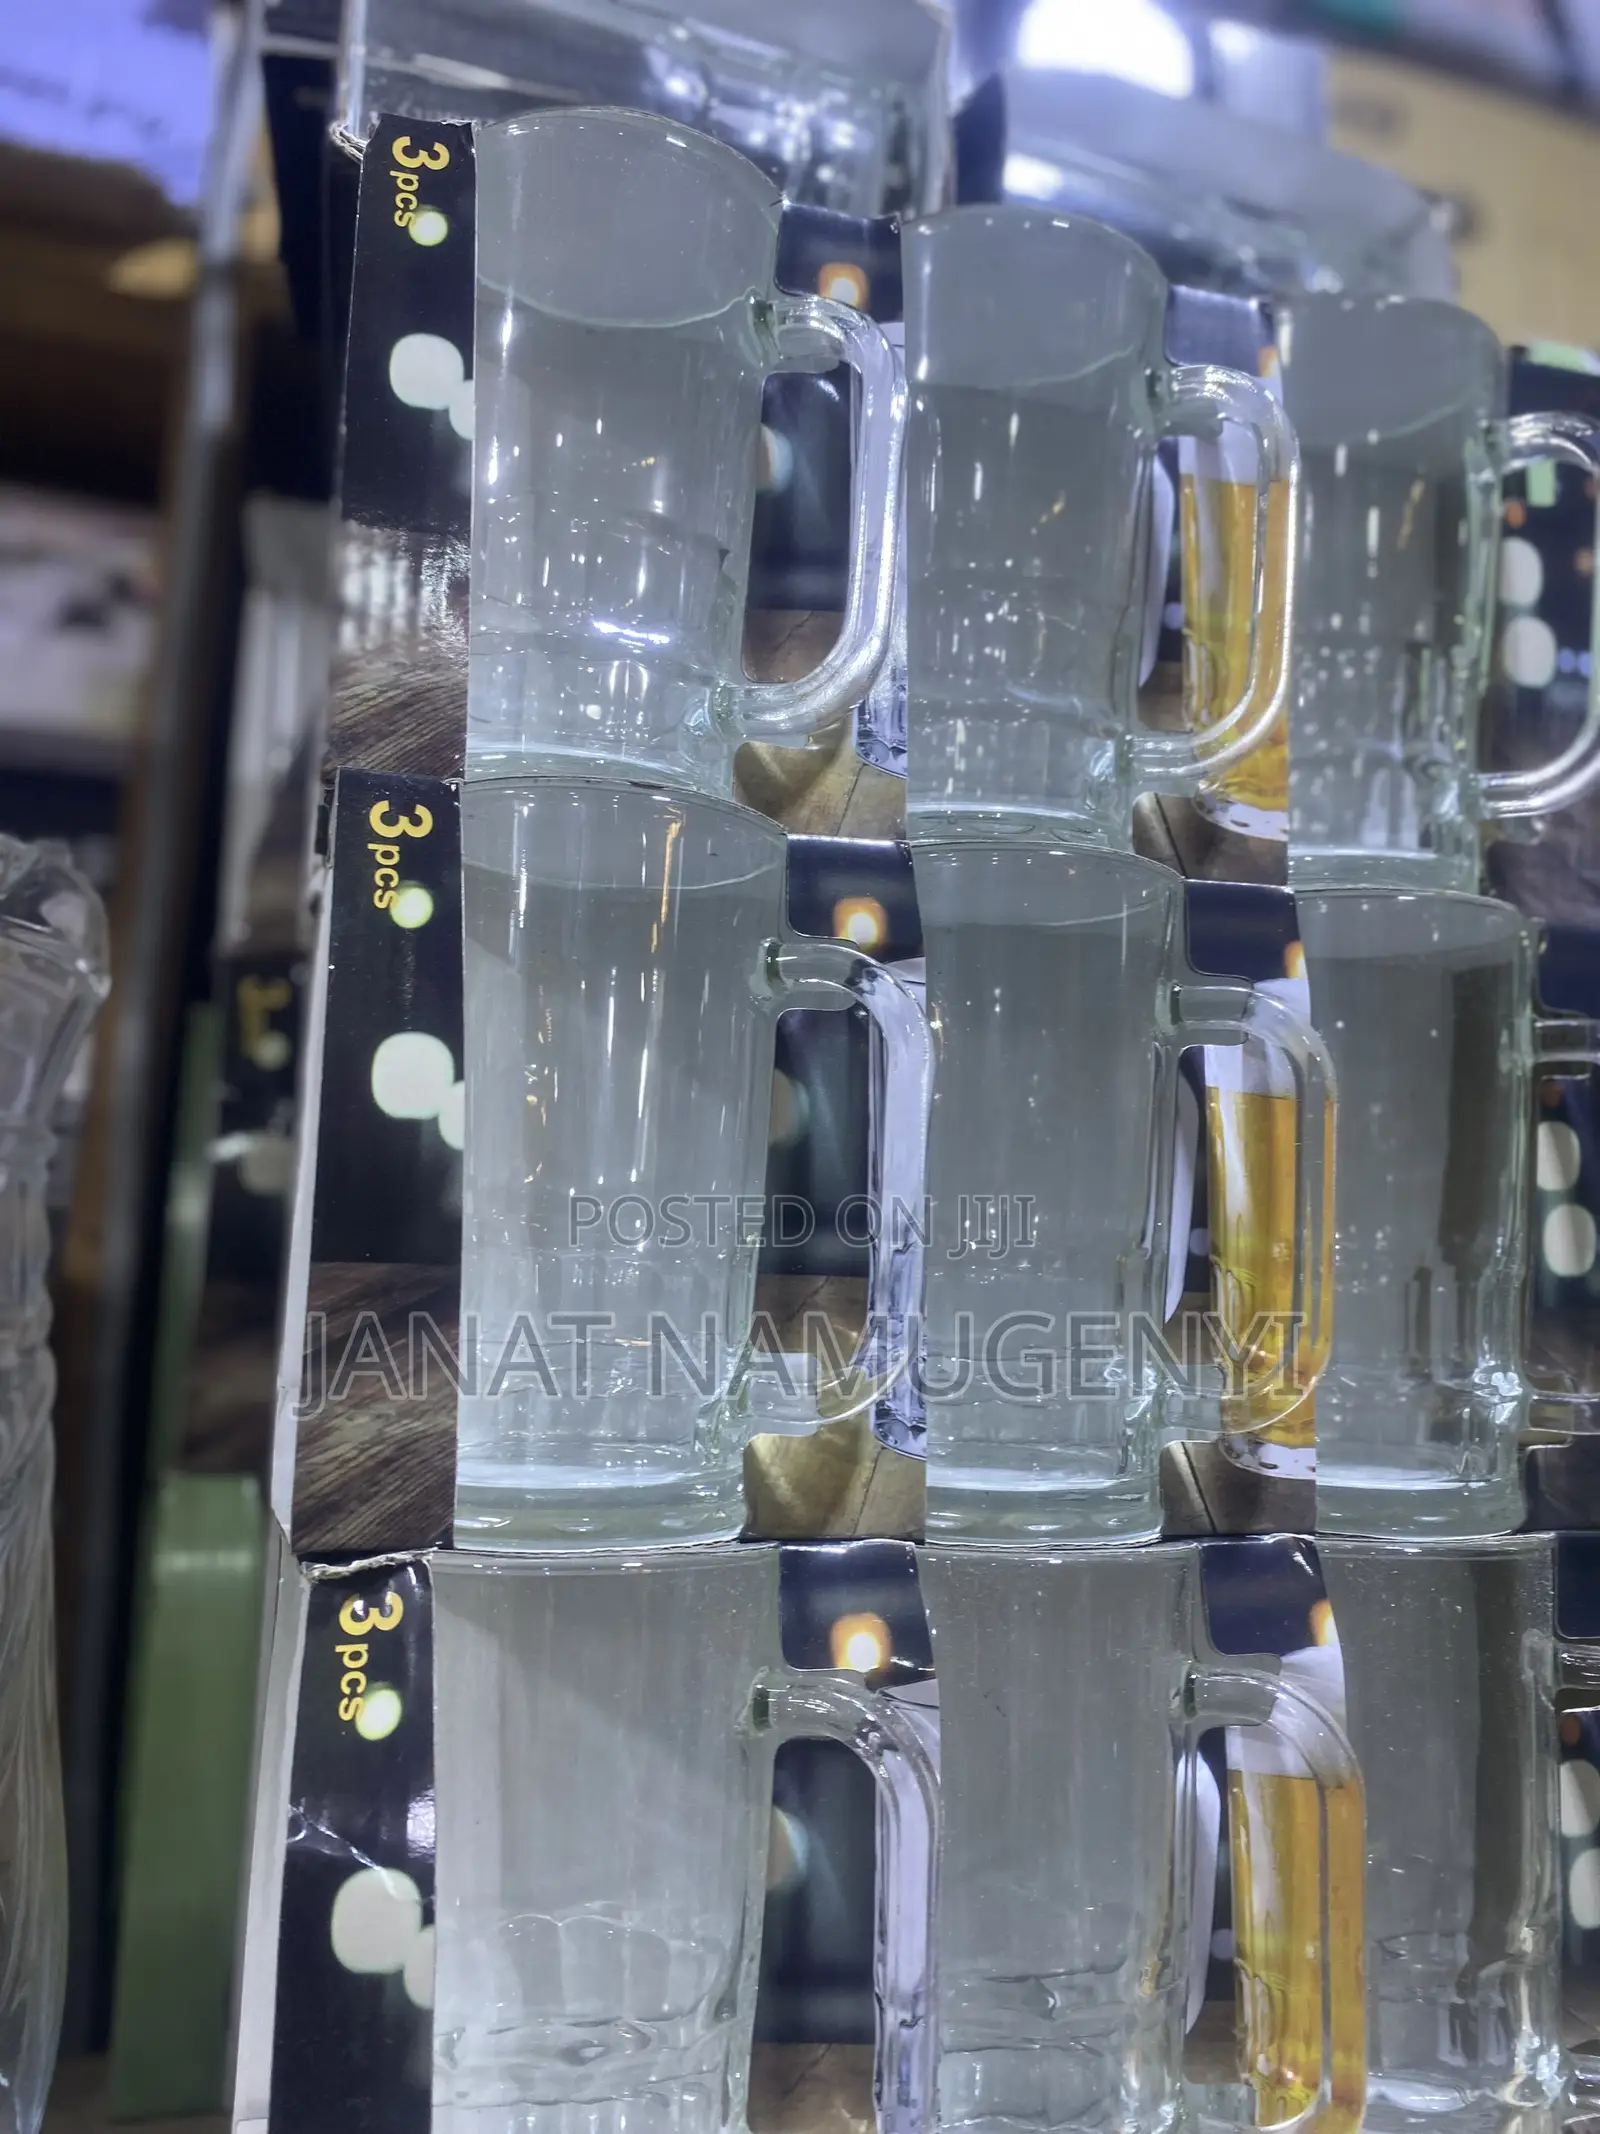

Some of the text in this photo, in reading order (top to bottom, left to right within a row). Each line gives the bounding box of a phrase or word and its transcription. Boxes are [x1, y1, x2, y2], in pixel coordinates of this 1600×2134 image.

[391, 135, 450, 171] 3
[389, 170, 420, 228] pcs
[366, 799, 434, 909] 3 pcs
[334, 1590, 404, 1722] 3 pcs
